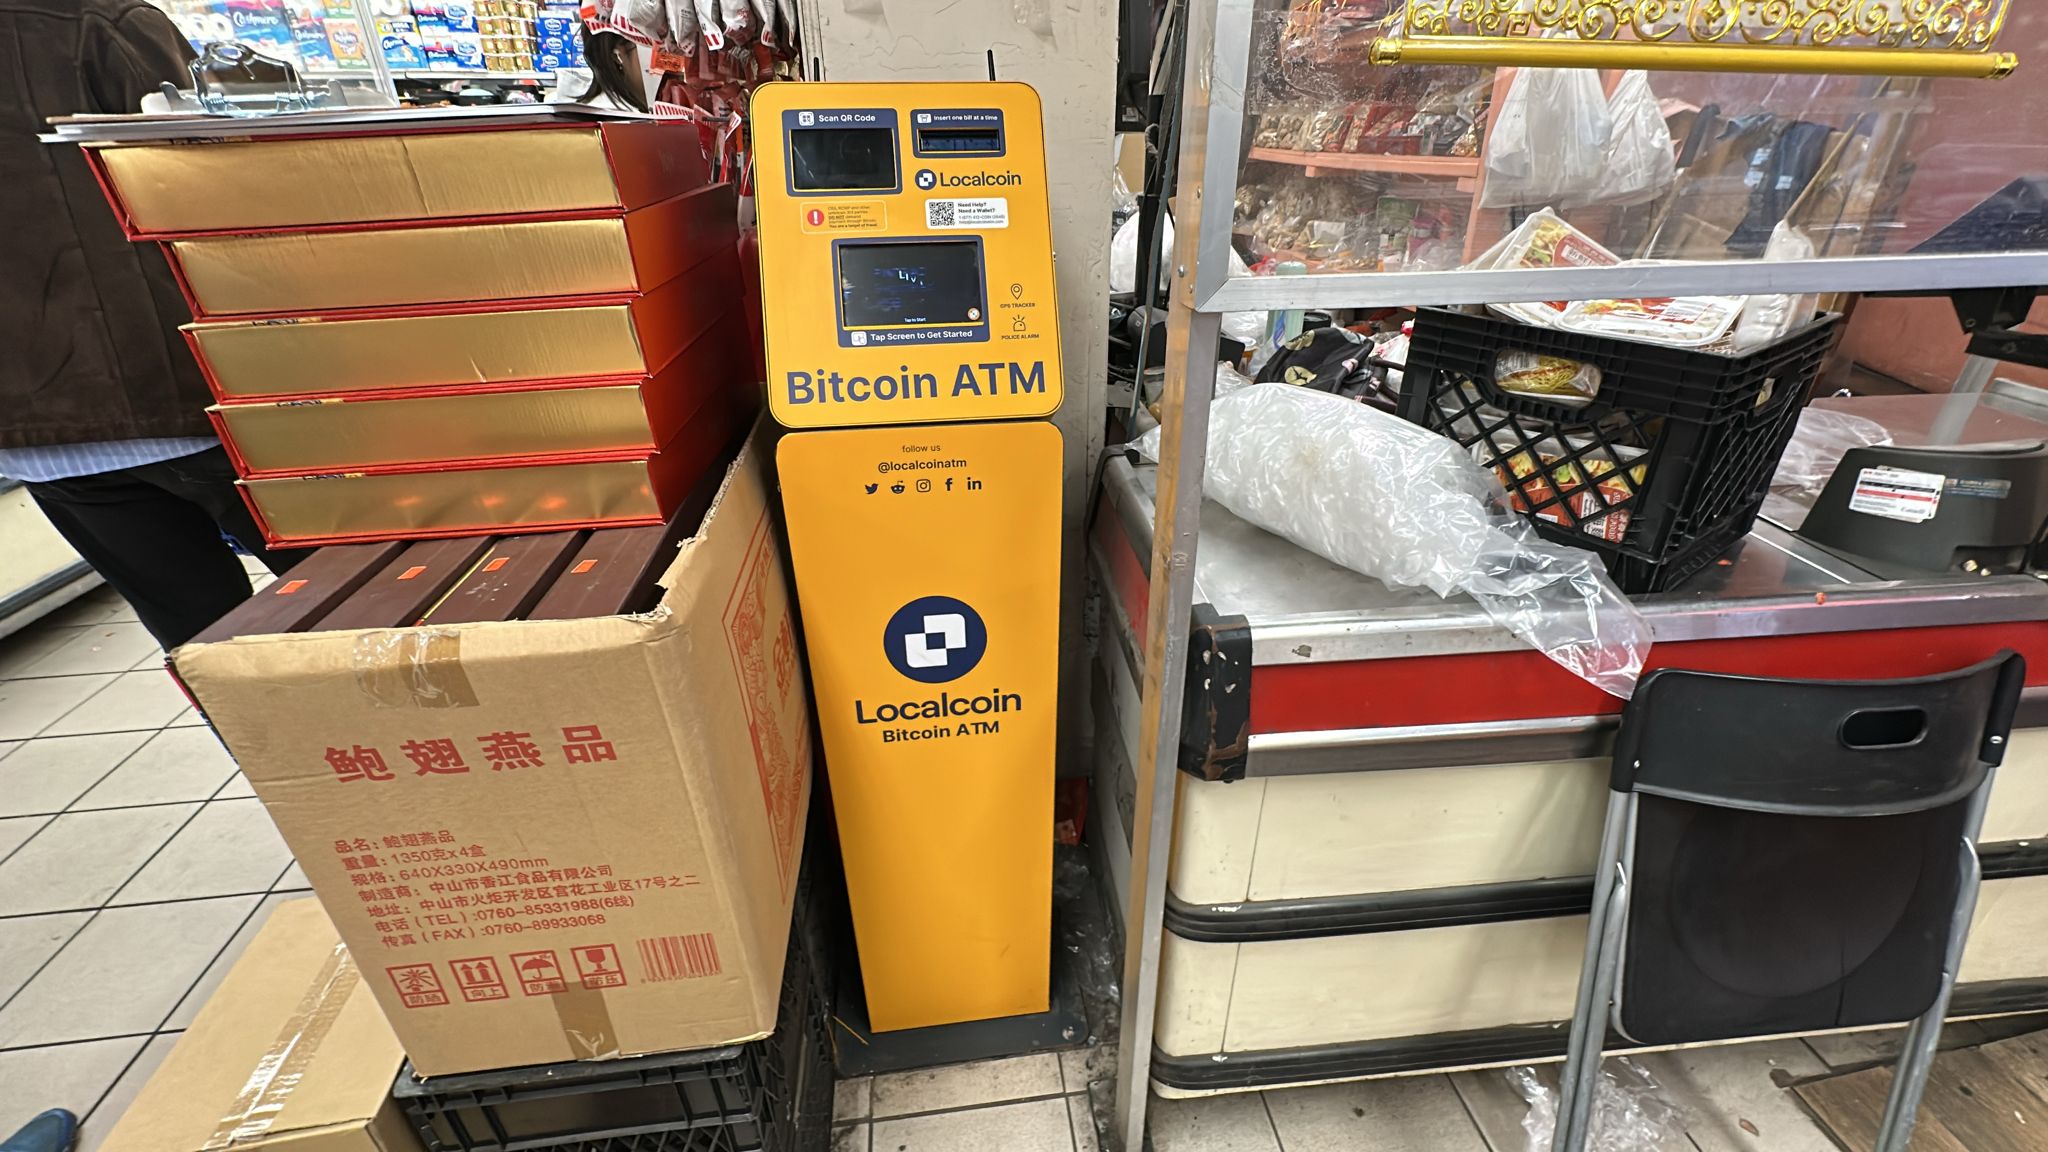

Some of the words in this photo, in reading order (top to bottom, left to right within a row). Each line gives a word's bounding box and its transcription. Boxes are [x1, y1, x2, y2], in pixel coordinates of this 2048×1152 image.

[818, 113, 839, 122] Scan
[841, 113, 853, 122] QR
[854, 113, 876, 122] Code
[939, 171, 1022, 187] Localcoin
[870, 333, 886, 342] Tap
[887, 332, 915, 340] Screen
[927, 331, 942, 339] Get
[943, 330, 973, 338] Started
[786, 365, 938, 405] Bitcoin
[951, 360, 1046, 397] ATM
[902, 445, 928, 453] follow
[878, 459, 967, 473] @localcoinatm
[855, 688, 1022, 724] Localcoin
[882, 725, 951, 743] Bitcoin
[956, 720, 1000, 737] ATM
[324, 724, 618, 783] 鲍翅燕品
